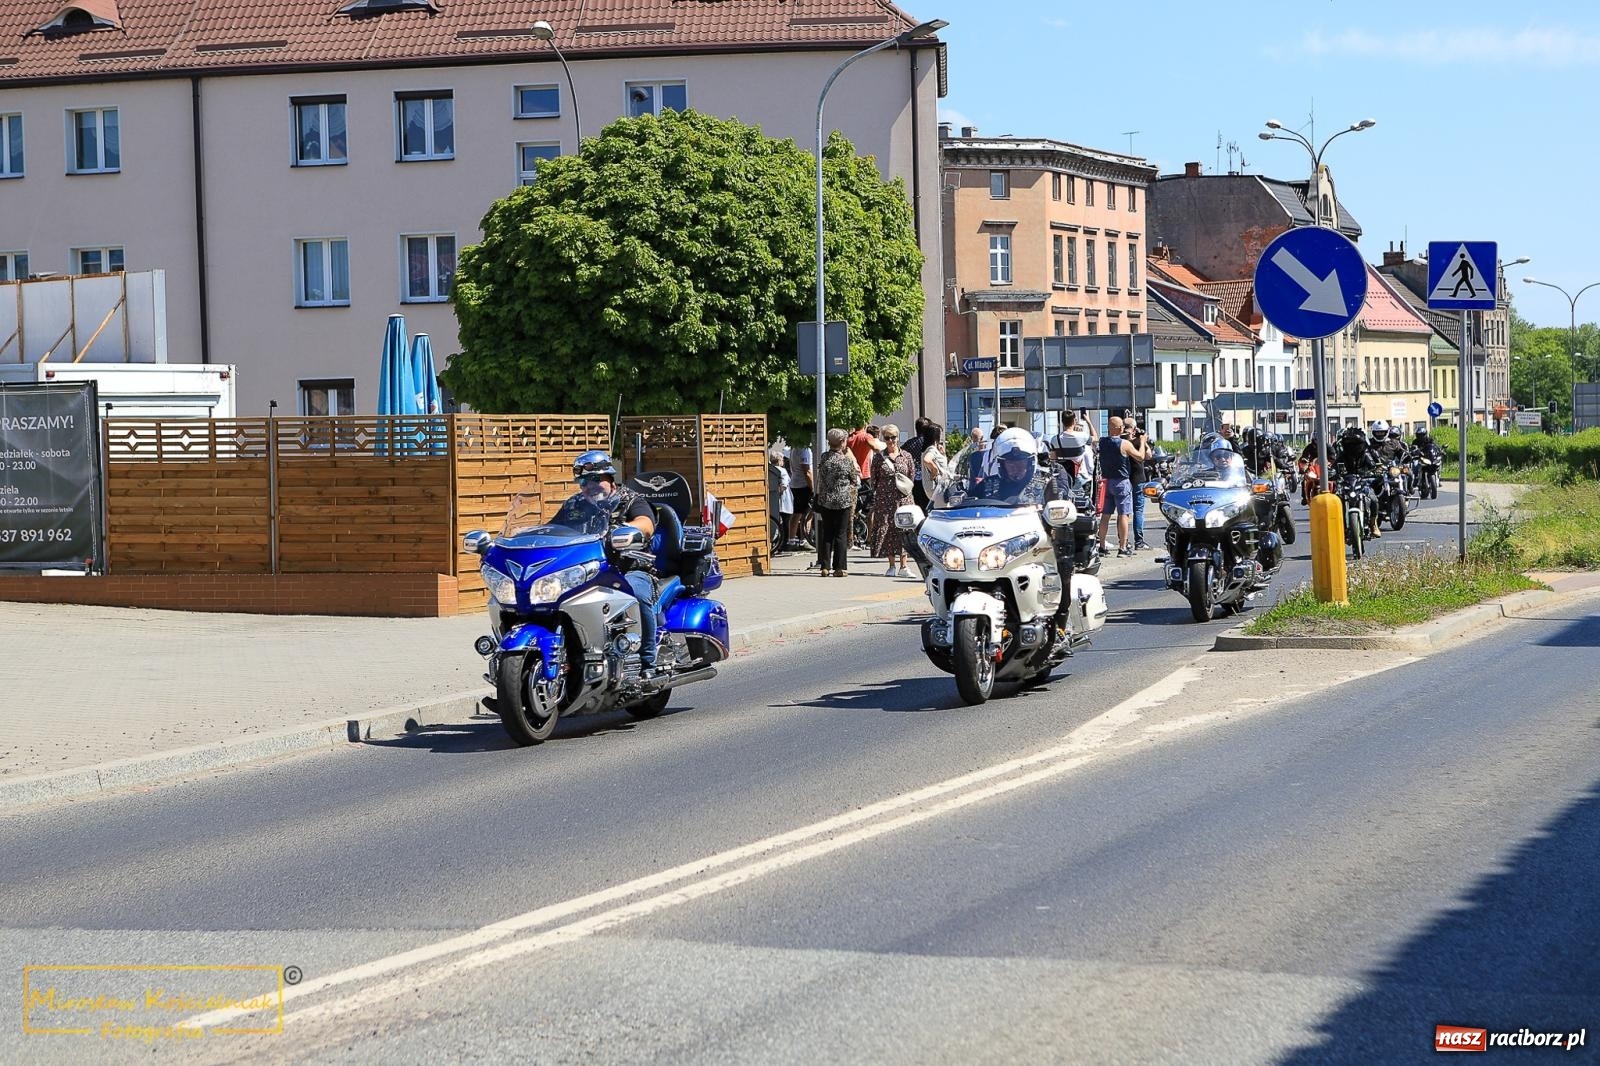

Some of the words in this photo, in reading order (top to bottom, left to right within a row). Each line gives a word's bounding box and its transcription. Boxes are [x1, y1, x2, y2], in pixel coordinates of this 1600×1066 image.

[0, 415, 74, 431] RASZAMY!
[41, 447, 71, 458] sobota
[12, 460, 36, 471] 23.00
[14, 496, 39, 506] 22.00
[20, 528, 44, 542] 891
[47, 528, 72, 542] 962
